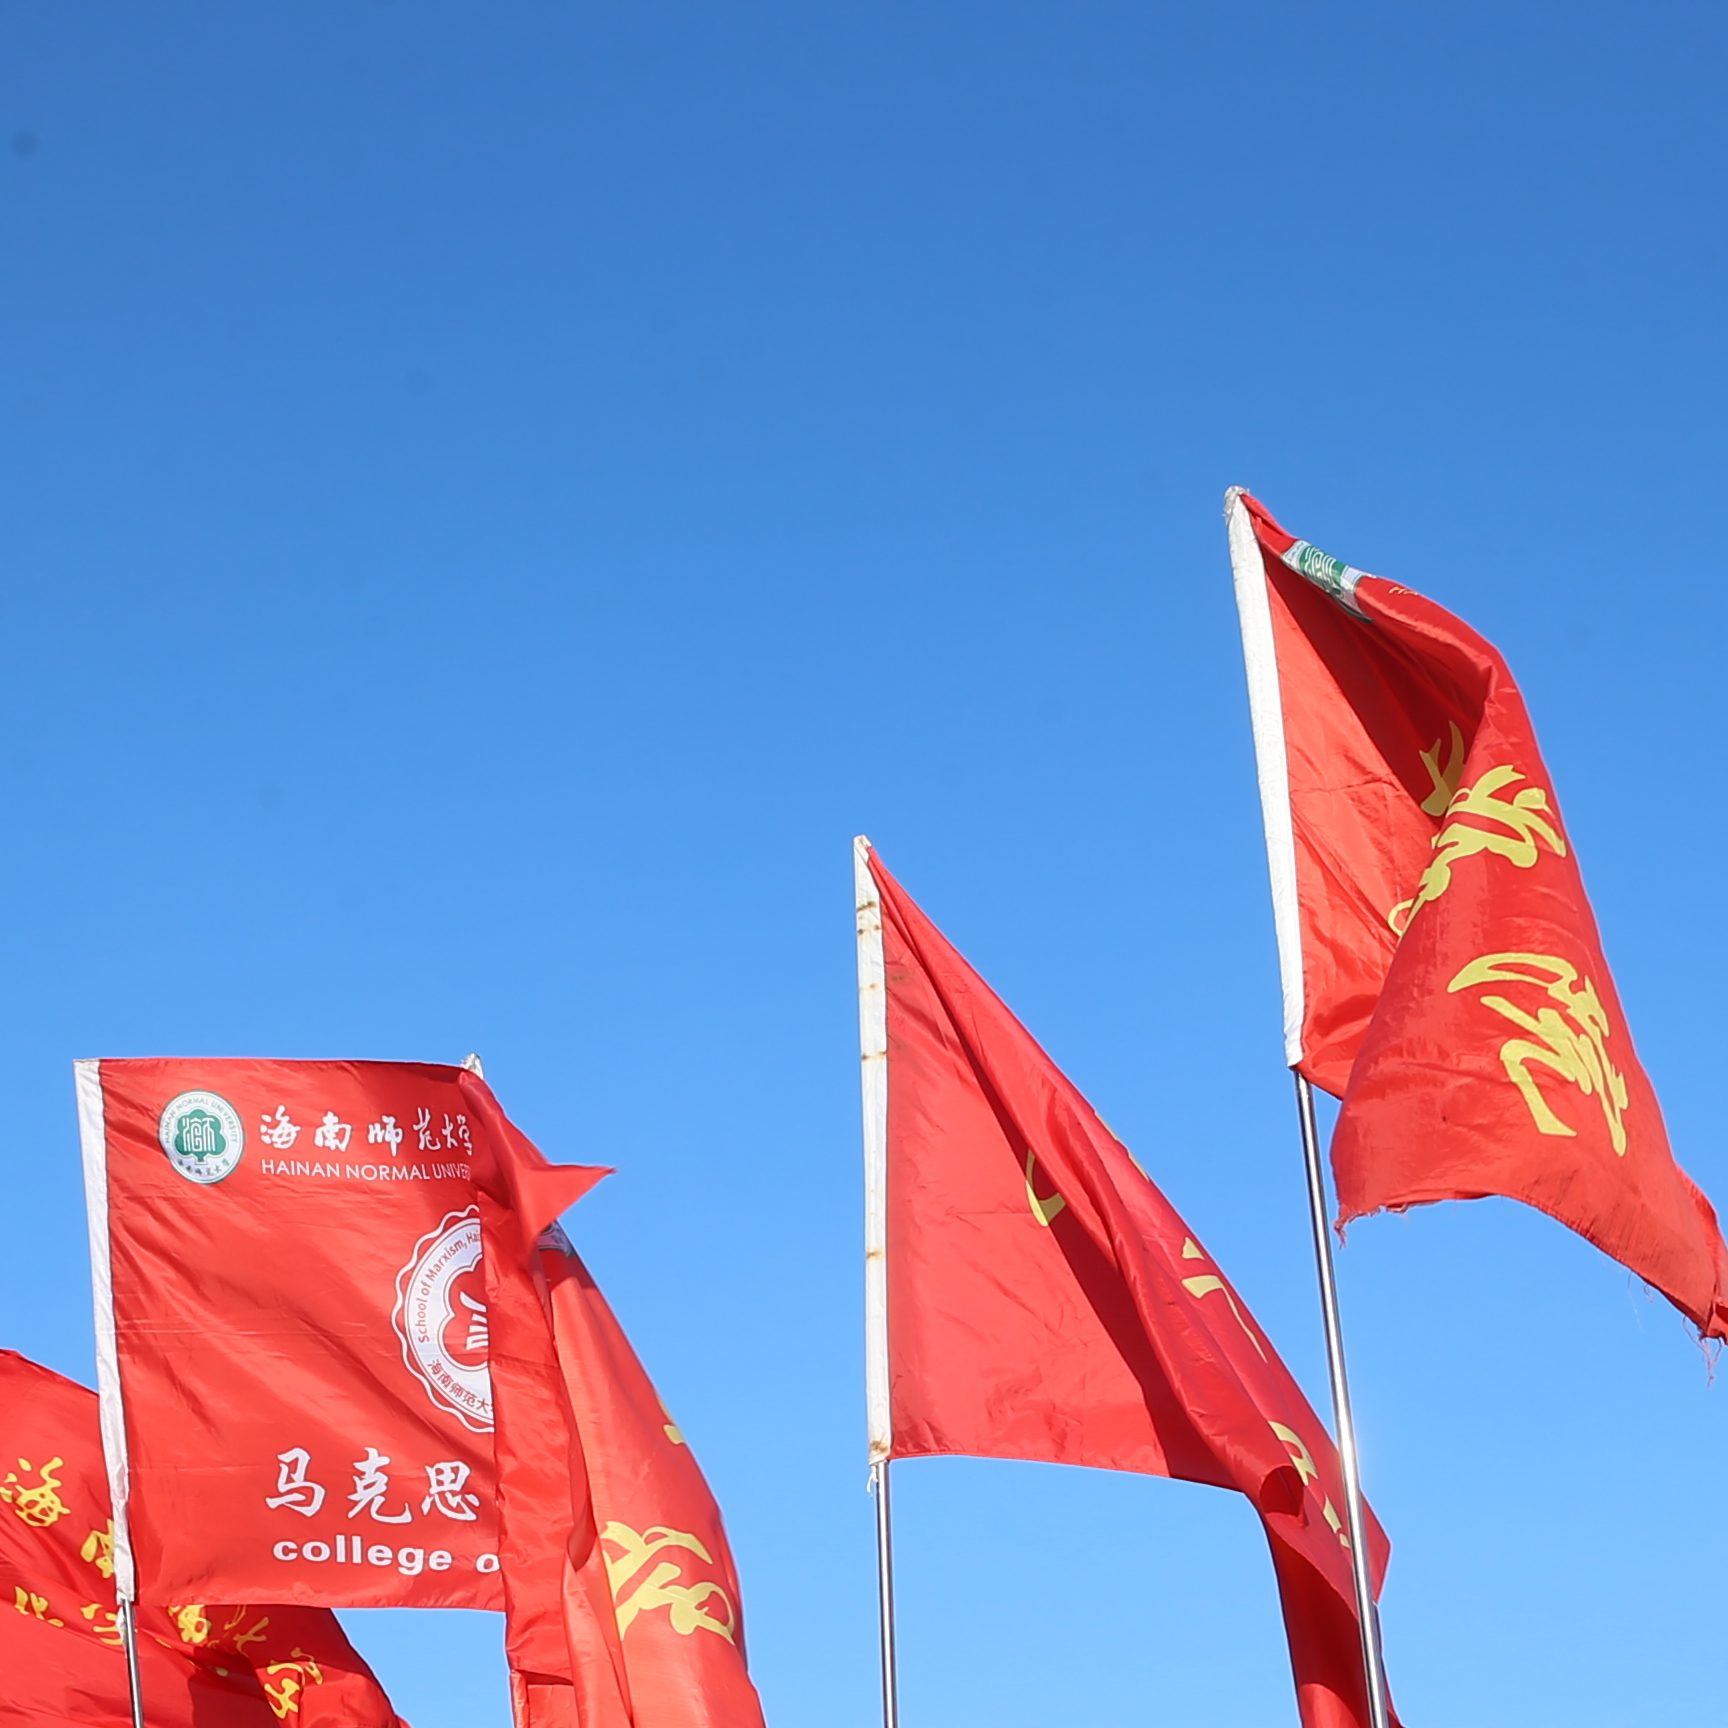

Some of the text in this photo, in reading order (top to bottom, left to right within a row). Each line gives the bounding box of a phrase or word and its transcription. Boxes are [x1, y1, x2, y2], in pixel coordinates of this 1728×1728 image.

[260, 1104, 473, 1156] 海南师范大学
[261, 1159, 341, 1178] HAINAN
[346, 1164, 431, 1181] NORMAL
[421, 1281, 432, 1295] of
[415, 1297, 429, 1343] School
[427, 1359, 494, 1414] 海南师范大
[265, 1446, 480, 1525] 马克思
[272, 1535, 453, 1575] college
